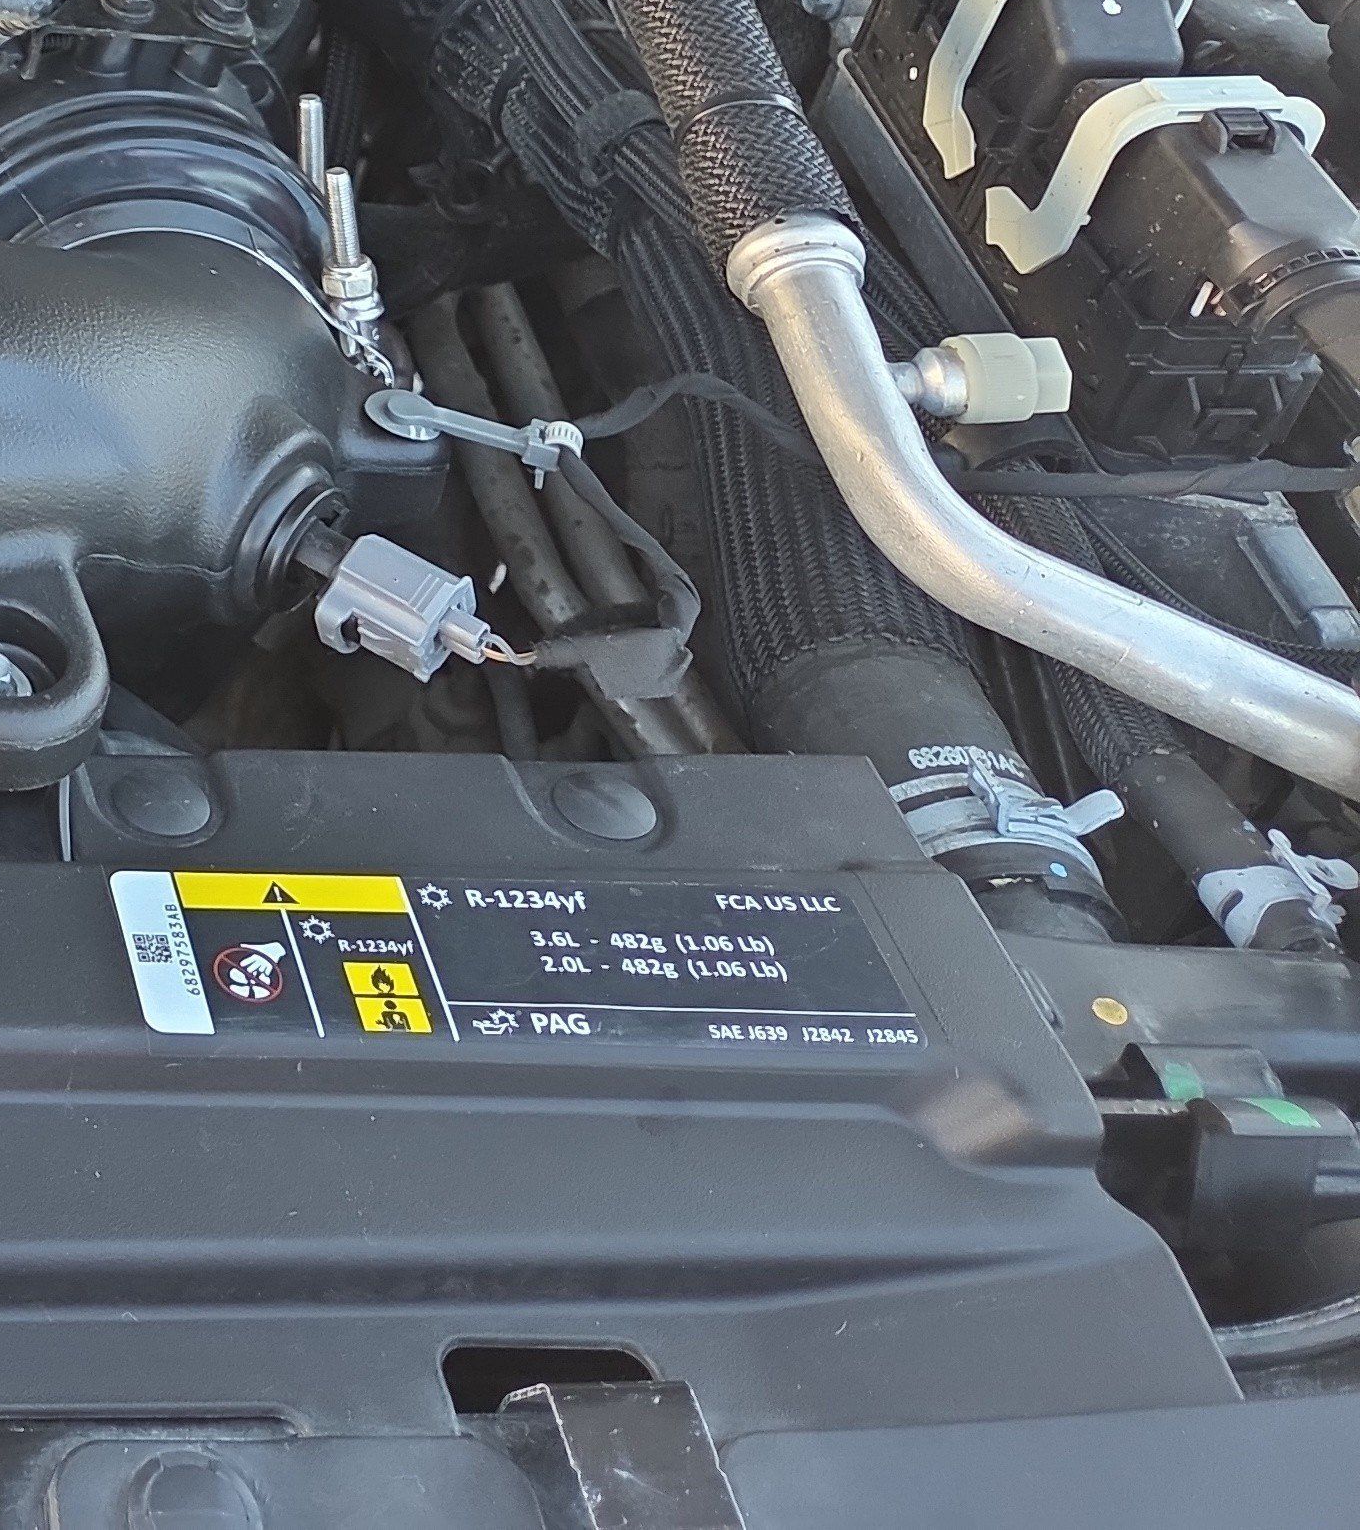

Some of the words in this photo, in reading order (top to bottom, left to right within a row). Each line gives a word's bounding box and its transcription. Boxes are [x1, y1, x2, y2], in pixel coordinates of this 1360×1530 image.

[464, 889, 587, 914] R-1234yf
[716, 894, 762, 911] FCA
[764, 895, 797, 912] US
[800, 895, 841, 912] LLC
[165, 903, 201, 996] 68297583AB
[338, 939, 414, 956] R-1234yf
[530, 931, 580, 947] 3.6L
[610, 933, 668, 954] 482g
[675, 934, 732, 954] (1.06
[737, 935, 775, 956] Lb)
[540, 956, 591, 973] 2.0L
[621, 958, 679, 979] 482g
[687, 958, 747, 981] (1.06
[752, 961, 788, 982] Lb)
[530, 1012, 591, 1035] PAG
[708, 1025, 744, 1040] SAE
[747, 1026, 788, 1041] J639
[802, 1027, 855, 1043] J2842
[866, 1029, 919, 1044] J2845
